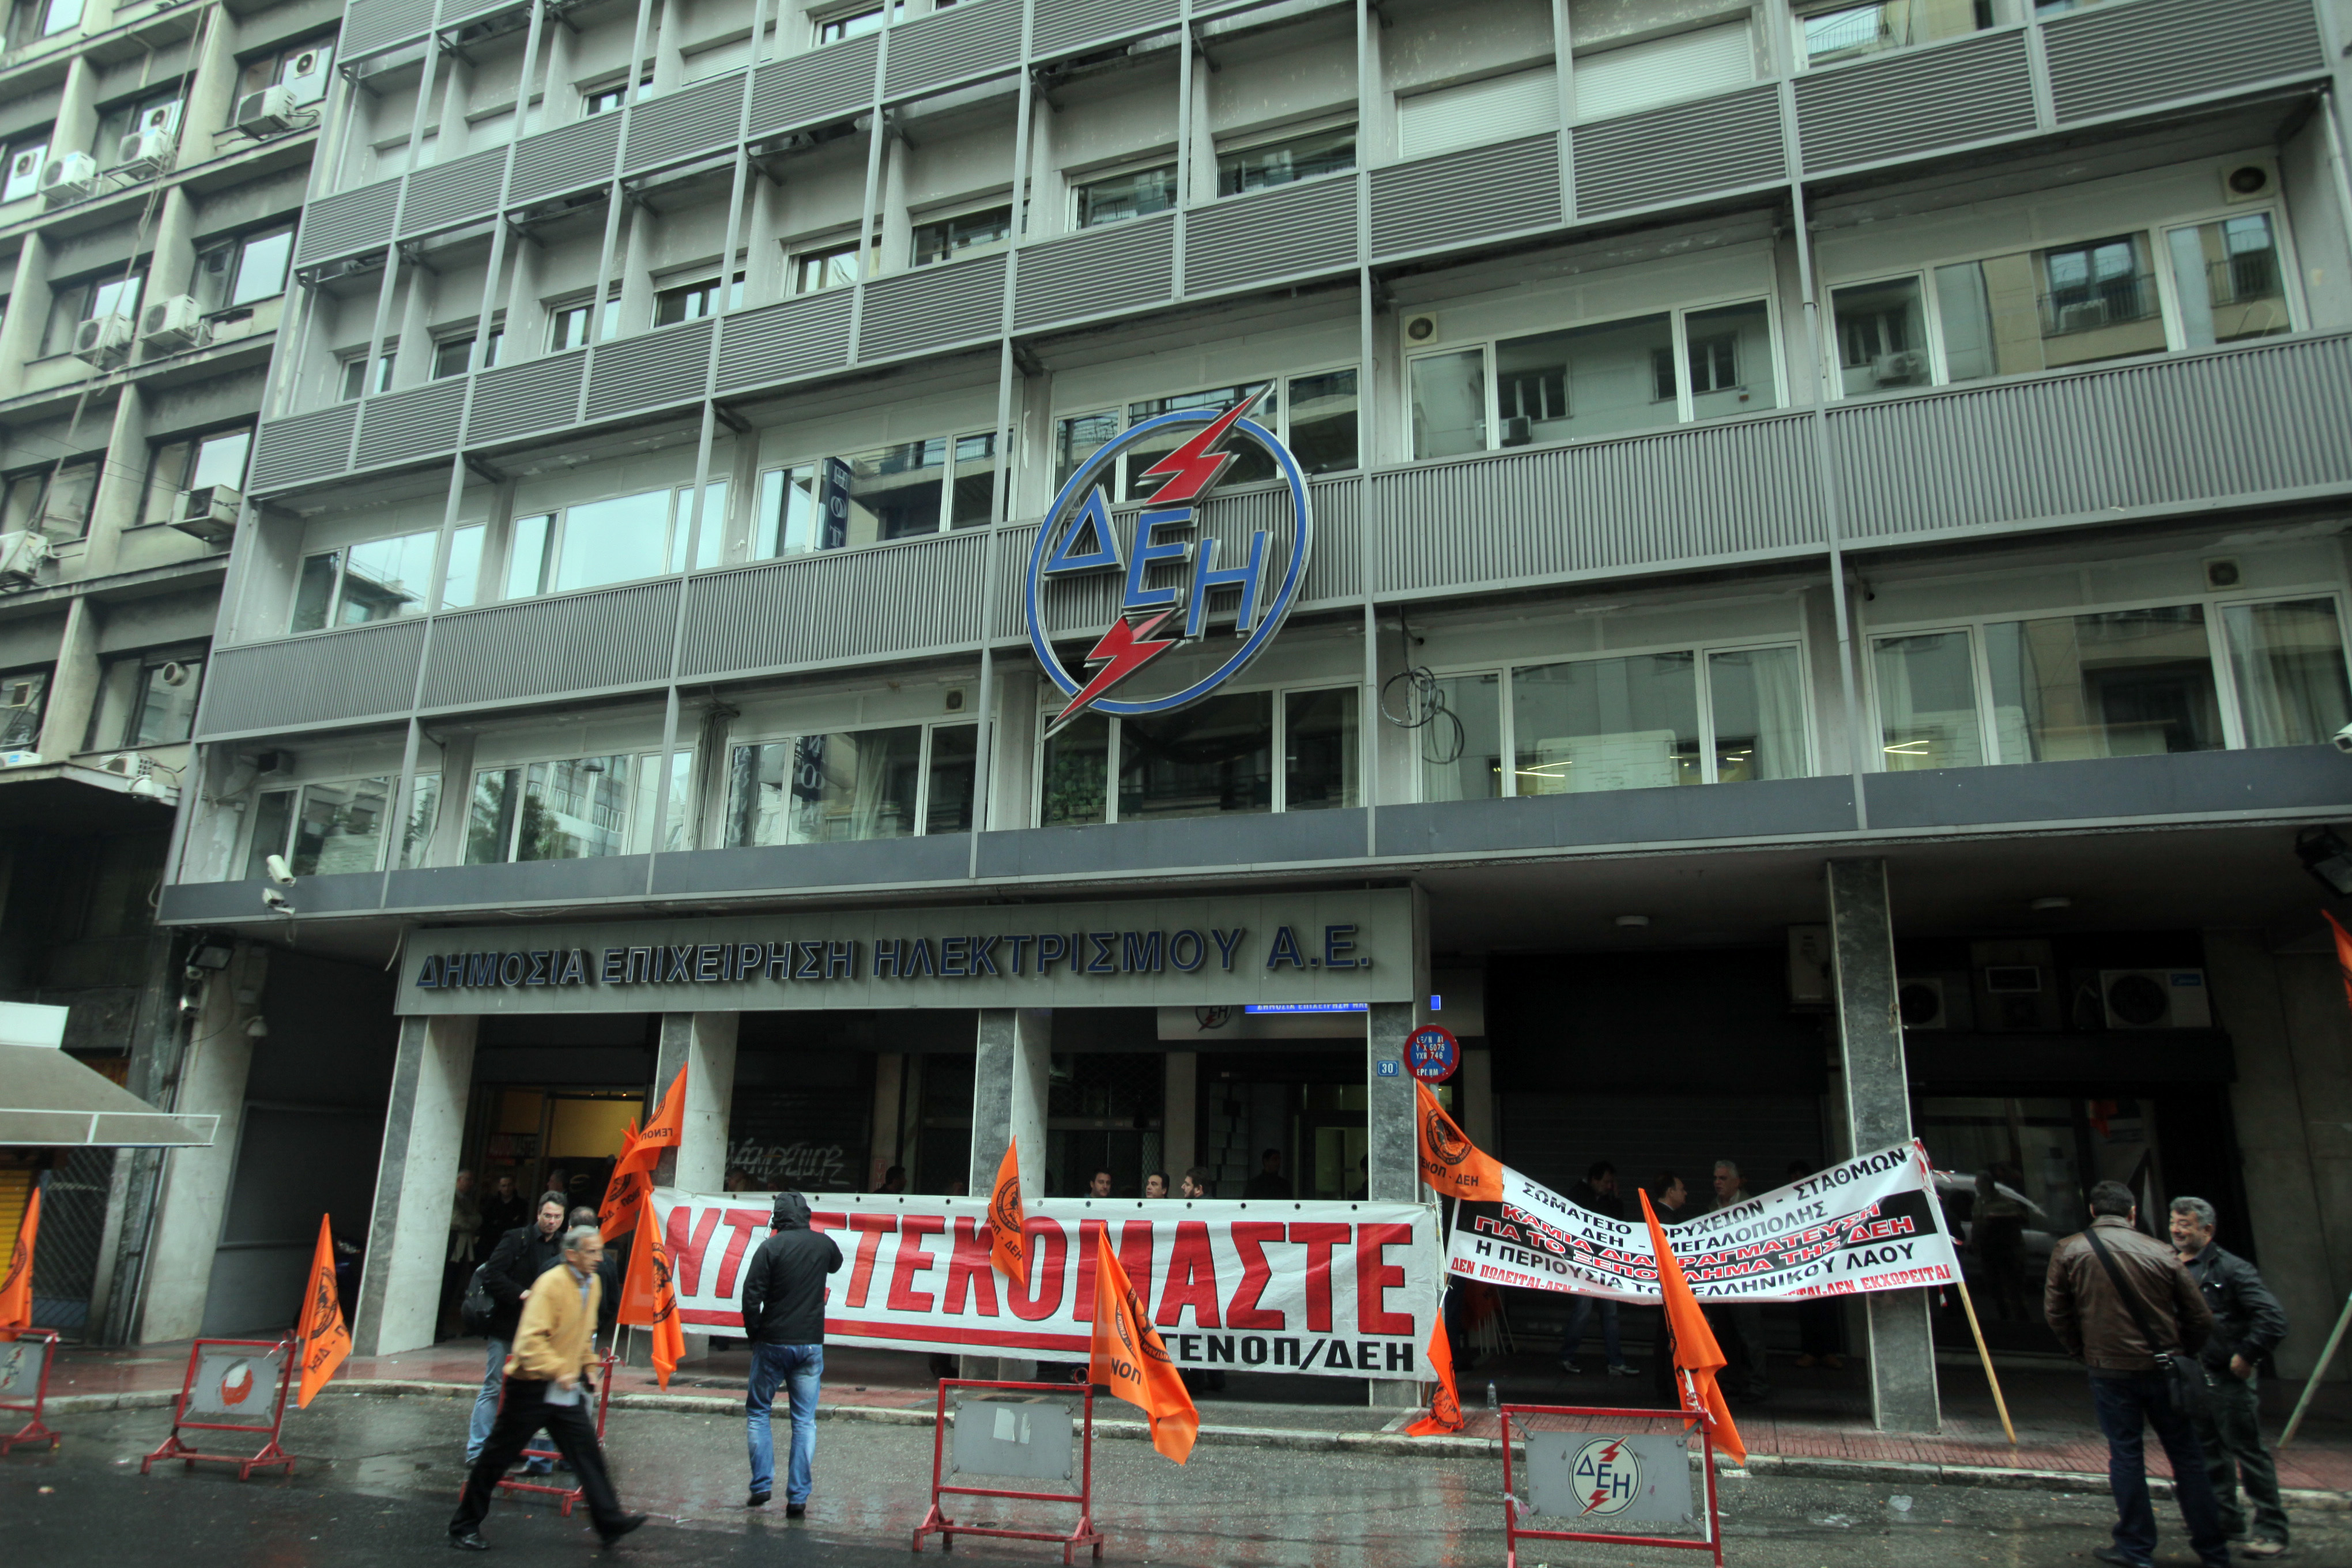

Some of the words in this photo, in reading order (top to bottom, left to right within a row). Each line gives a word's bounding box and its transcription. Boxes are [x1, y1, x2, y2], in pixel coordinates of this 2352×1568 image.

[1044, 484, 1272, 641] ΔΕΗ
[416, 949, 586, 988] ΔΗΜΟΣΙΑ
[601, 940, 854, 983] ΕΠΙΧΕΙΡΗΣΗ
[873, 927, 1243, 978] ΗΛΕΚΤΡΙΣΜΟΥ
[1267, 924, 1372, 970] Α.Ε.
[1382, 1064, 1393, 1073] 30
[1455, 1174, 1479, 1186] ΔΕΗ
[1522, 1182, 1632, 1235] ΣΩΜΑΤΕΙΟ
[1793, 1147, 1908, 1201] ΣΤΑΘΜΩΝ
[1004, 1240, 1023, 1261] ΔΕΗ
[1474, 1215, 1522, 1242] ΓΙΑ
[1526, 1230, 1566, 1254] ΤΟ
[1572, 1249, 1774, 1283] ΞΕΠΟΛΗΜΑ
[1780, 1237, 1841, 1265] ΤΗΣ
[1846, 1215, 1916, 1245] ΔΕΗ
[1501, 1203, 1594, 1254] ΚΑΜΙΑ
[1599, 1201, 1882, 1268] ΔΙΑΡΑΓΜΑΤΕΥΣΗ
[1581, 1227, 1624, 1247] ΔΕΗ
[1451, 1257, 1476, 1275] ΔΕΝ
[1860, 1263, 1952, 1290] ΕΚΧΩΡΕΙΤΑΙ
[1475, 1239, 1491, 1257] Η
[1498, 1245, 1624, 1290] ΠΕΡΙΟΥΣΙΑ
[1845, 1242, 1914, 1271] ΛΑΟΥ
[1575, 1453, 1631, 1499] ΔΕΗ
